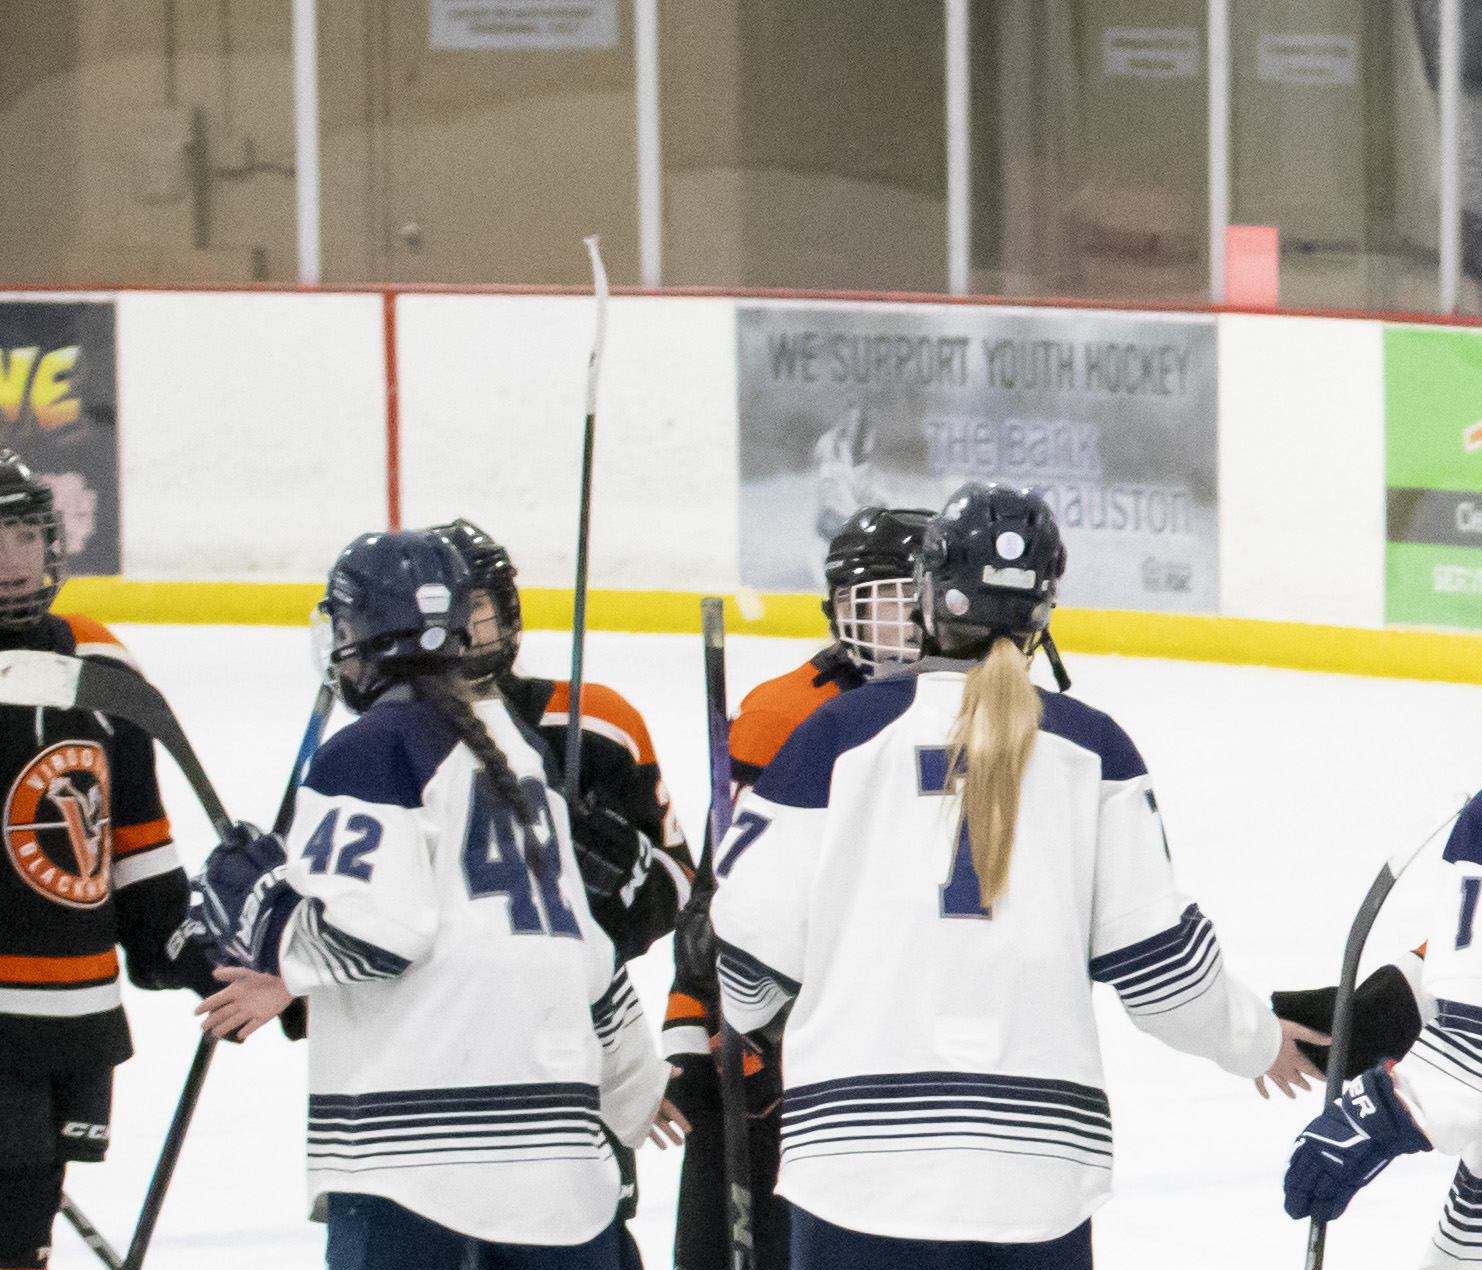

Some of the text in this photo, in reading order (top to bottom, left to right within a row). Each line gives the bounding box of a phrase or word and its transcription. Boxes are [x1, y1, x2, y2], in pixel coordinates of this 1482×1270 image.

[768, 333, 1192, 395] WE SUPPORT YOUTH HOCKEY
[301, 807, 383, 883] 42
[714, 810, 772, 879] 7
[61, 1122, 109, 1140] CC
